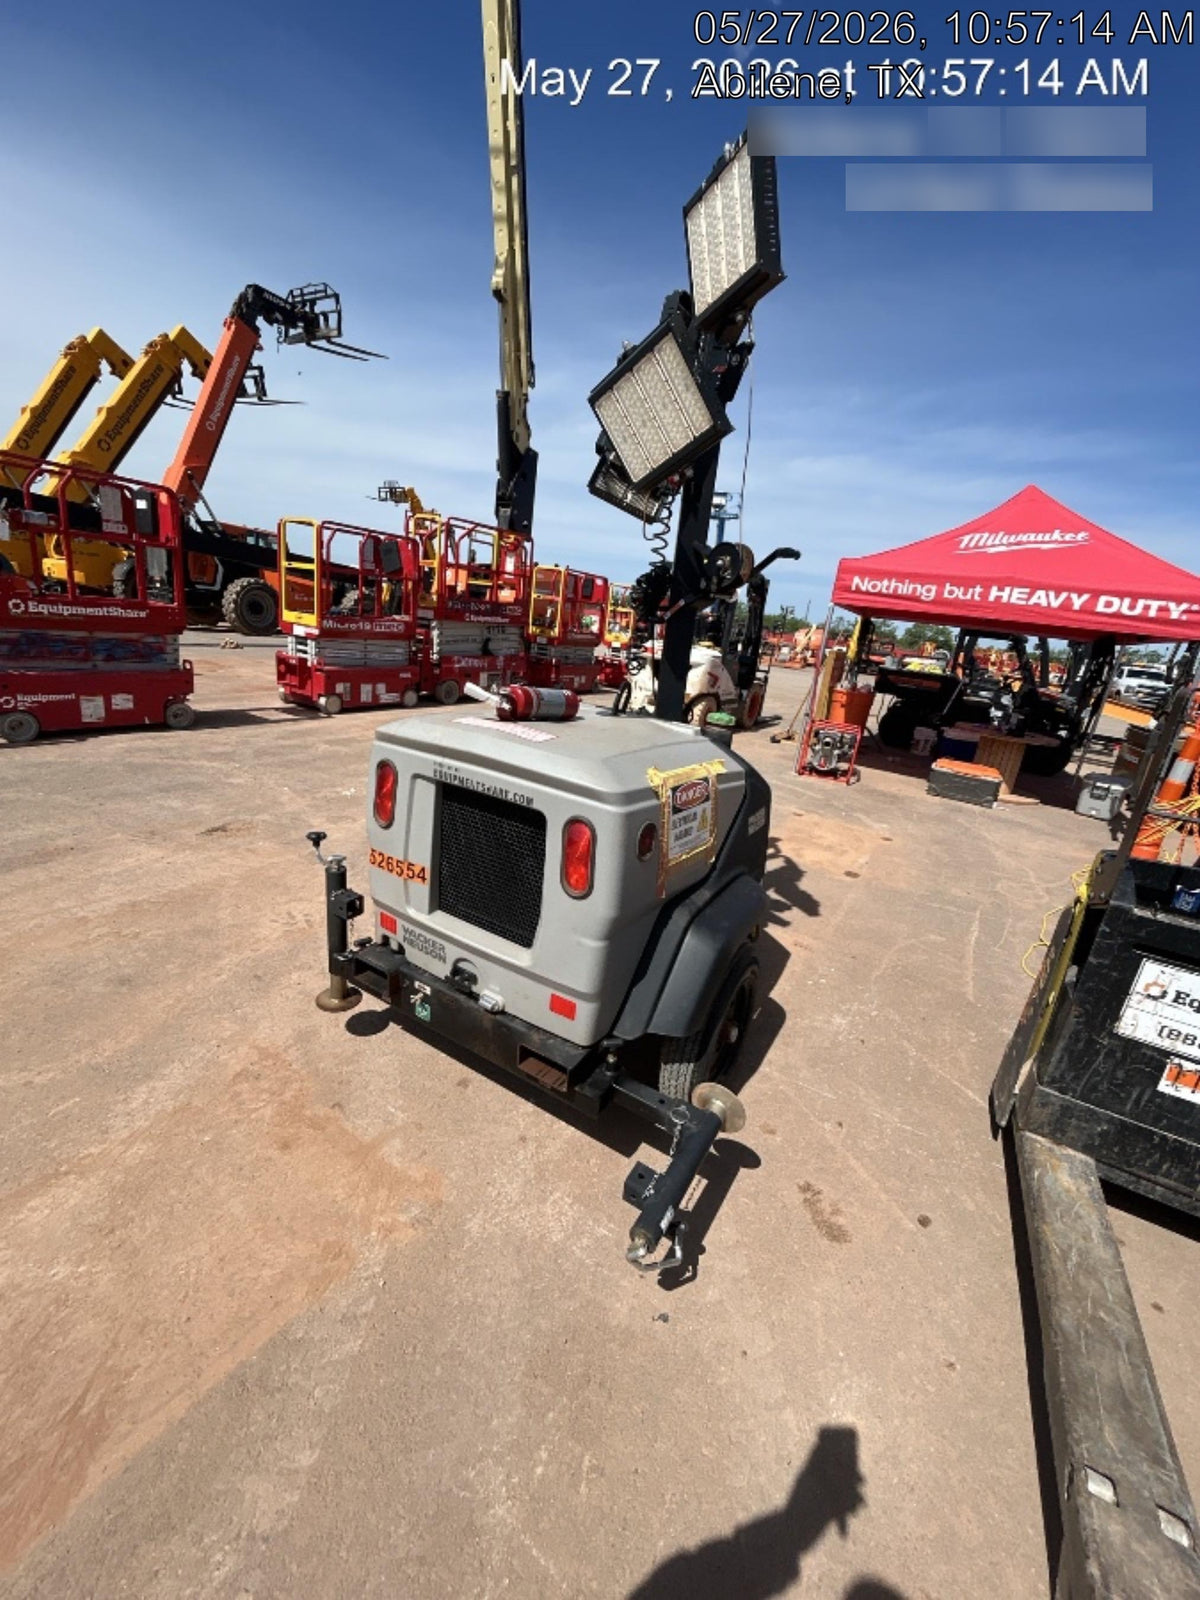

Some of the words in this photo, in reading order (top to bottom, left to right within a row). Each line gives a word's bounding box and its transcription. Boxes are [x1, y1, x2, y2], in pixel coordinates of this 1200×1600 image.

[25, 365, 76, 439] EquipmentShare
[107, 363, 165, 440] EquipmentShare
[955, 528, 1091, 550] Milwaukee
[850, 575, 938, 602] Nothing
[943, 582, 982, 602] but
[987, 585, 1092, 612] HEAVY
[28, 601, 147, 618] EquipmentShare
[369, 848, 427, 882] 526554
[401, 924, 447, 953] WACKER
[401, 936, 448, 965] NEUSON
